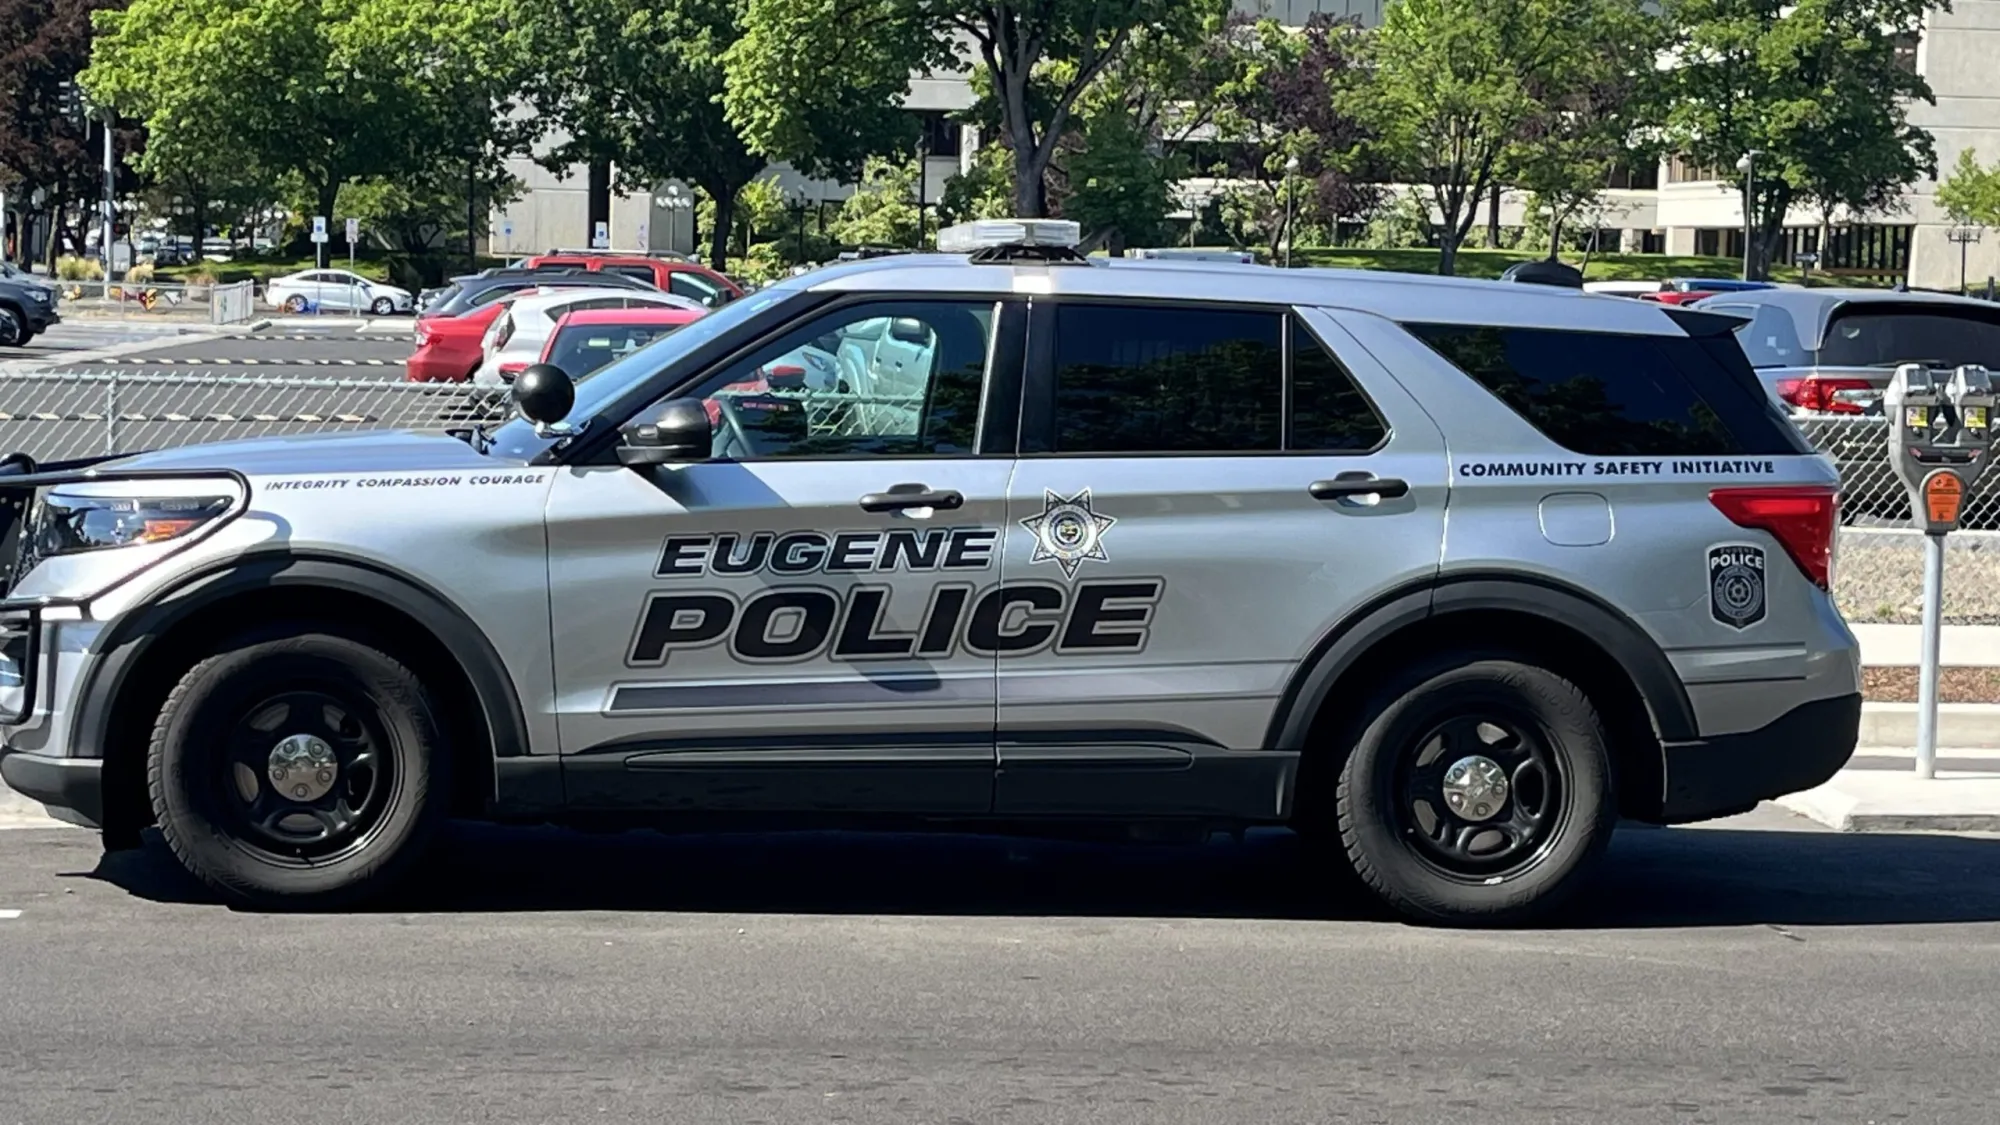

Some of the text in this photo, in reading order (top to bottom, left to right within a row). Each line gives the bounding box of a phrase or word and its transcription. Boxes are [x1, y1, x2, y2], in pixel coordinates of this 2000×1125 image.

[1459, 460, 1775, 477] COMMUNITY SAFETY INITIATIVE
[265, 474, 546, 491] INTEGRITY COMPASSION COURAGE
[654, 529, 999, 577] EUGENE
[1711, 553, 1764, 570] POLICE
[627, 579, 1163, 666] POLICE
